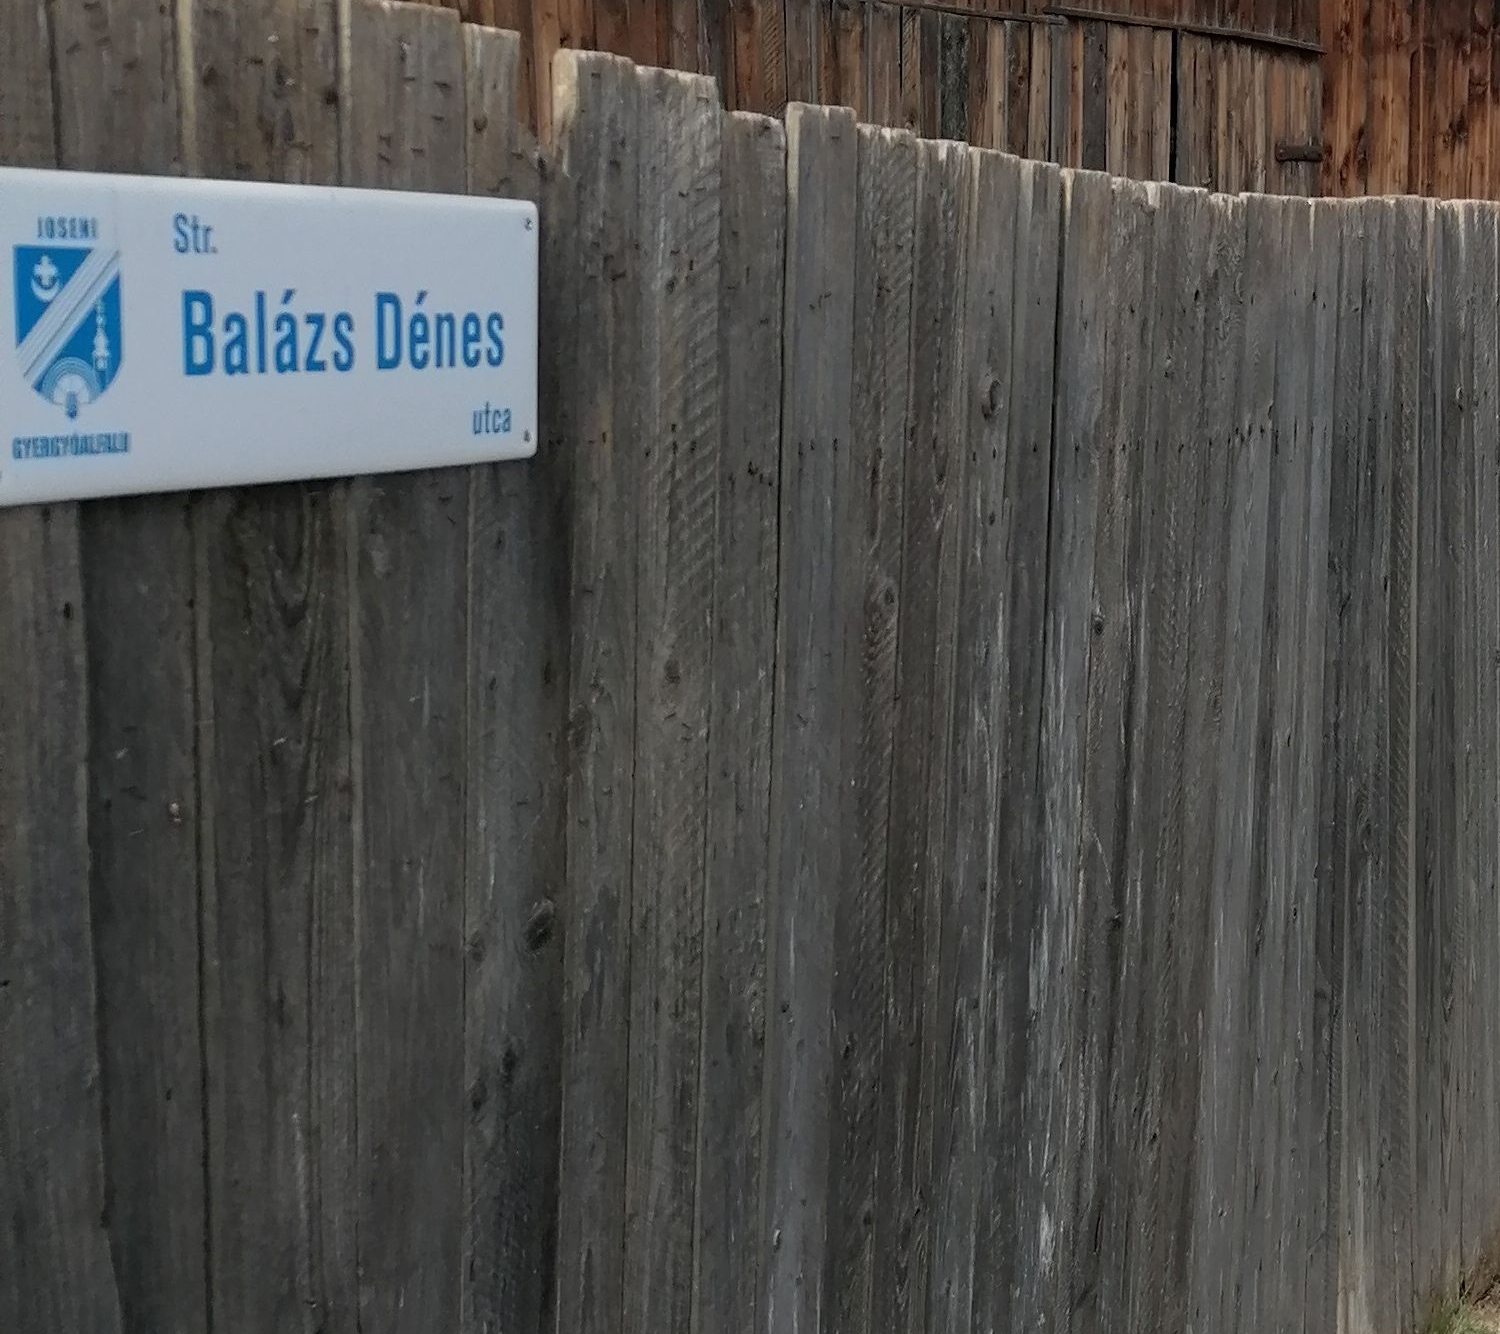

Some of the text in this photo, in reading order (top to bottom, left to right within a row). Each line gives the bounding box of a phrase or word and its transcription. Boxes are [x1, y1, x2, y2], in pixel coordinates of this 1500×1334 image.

[37, 216, 98, 239] JOSENI
[173, 213, 218, 254] Str.
[182, 290, 505, 376] Balázs Dénes
[472, 402, 513, 435] utca
